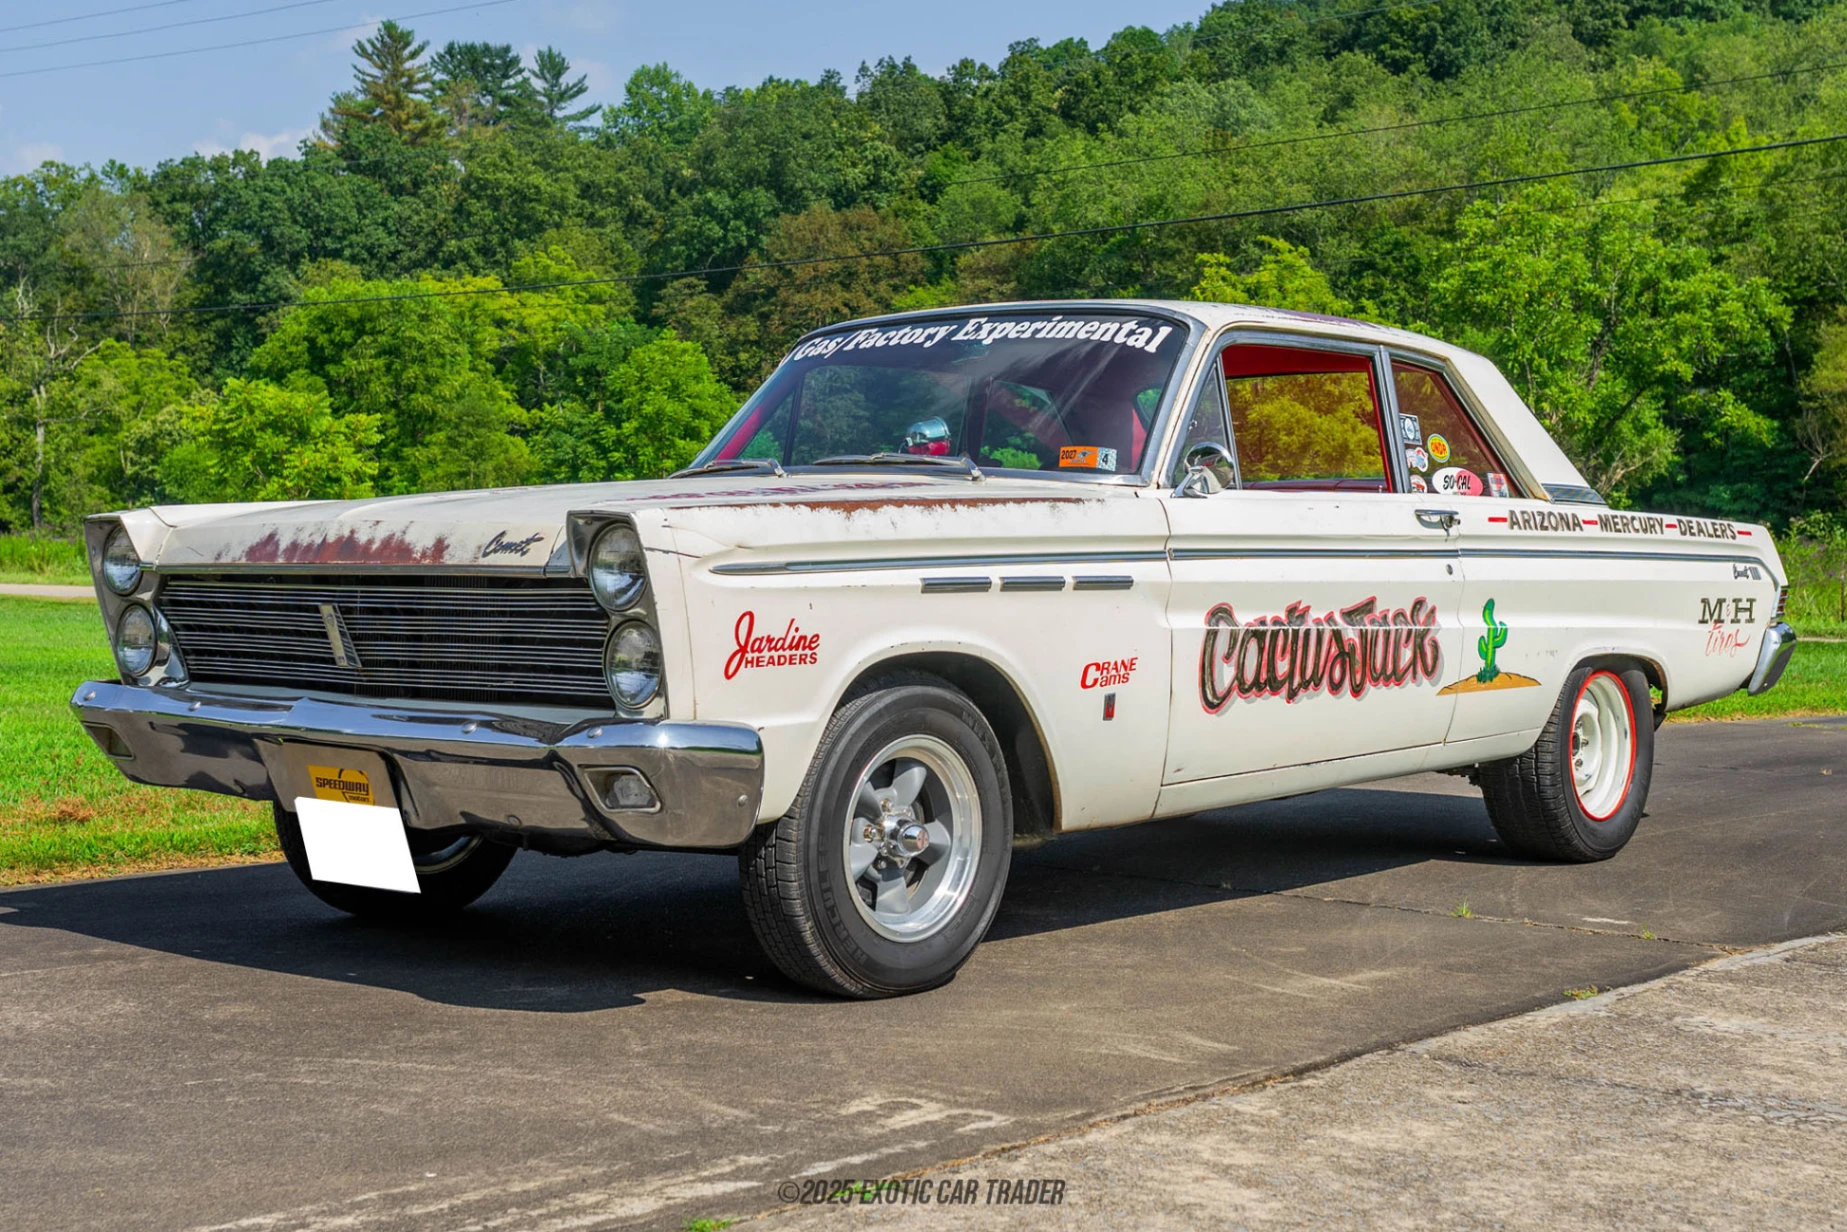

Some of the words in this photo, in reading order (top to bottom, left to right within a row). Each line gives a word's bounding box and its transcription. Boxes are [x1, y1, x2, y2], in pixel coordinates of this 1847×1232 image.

[951, 315, 1172, 353] Experimental
[1061, 450, 1077, 461] 2027
[1101, 454, 1109, 467] 4
[1508, 510, 1584, 532] ARIZONA
[1598, 514, 1665, 535] MERCURY
[1677, 518, 1737, 540] DEALERS
[482, 530, 544, 558] Comet
[724, 611, 820, 680] Jardine
[744, 652, 818, 668] HEADERS
[315, 777, 369, 796] SPEEDWAY
